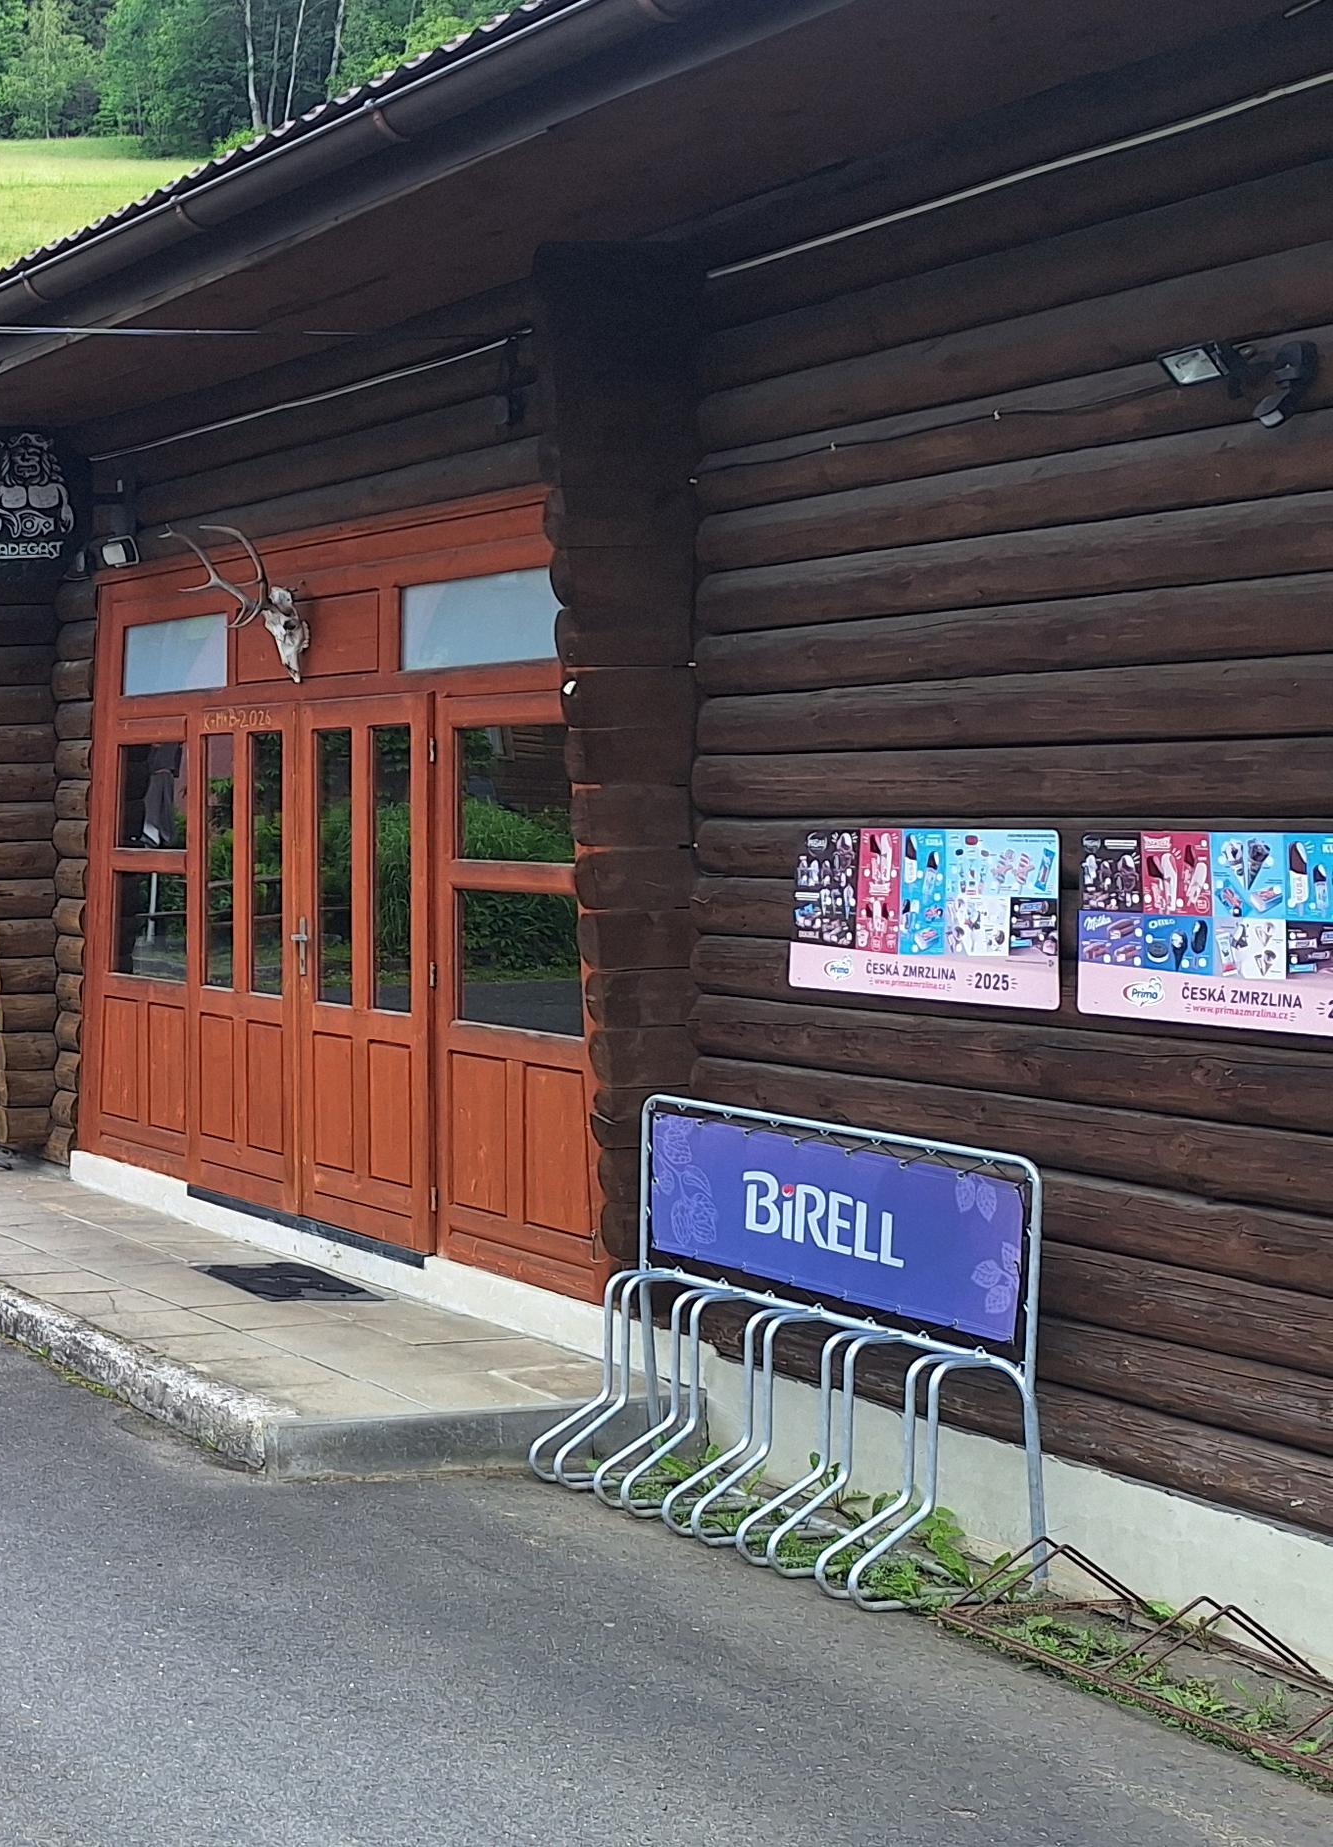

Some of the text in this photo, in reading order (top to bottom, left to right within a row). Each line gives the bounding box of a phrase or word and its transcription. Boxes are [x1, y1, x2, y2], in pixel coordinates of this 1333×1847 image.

[866, 958, 956, 981] ČESKÁ ZMRZLINA
[974, 972, 1010, 991] 2025
[1181, 981, 1226, 1003] ČESKÁ
[1230, 989, 1303, 1009] ZMRZLINA
[1192, 1004, 1289, 1020] www.primazmrzlina.cz
